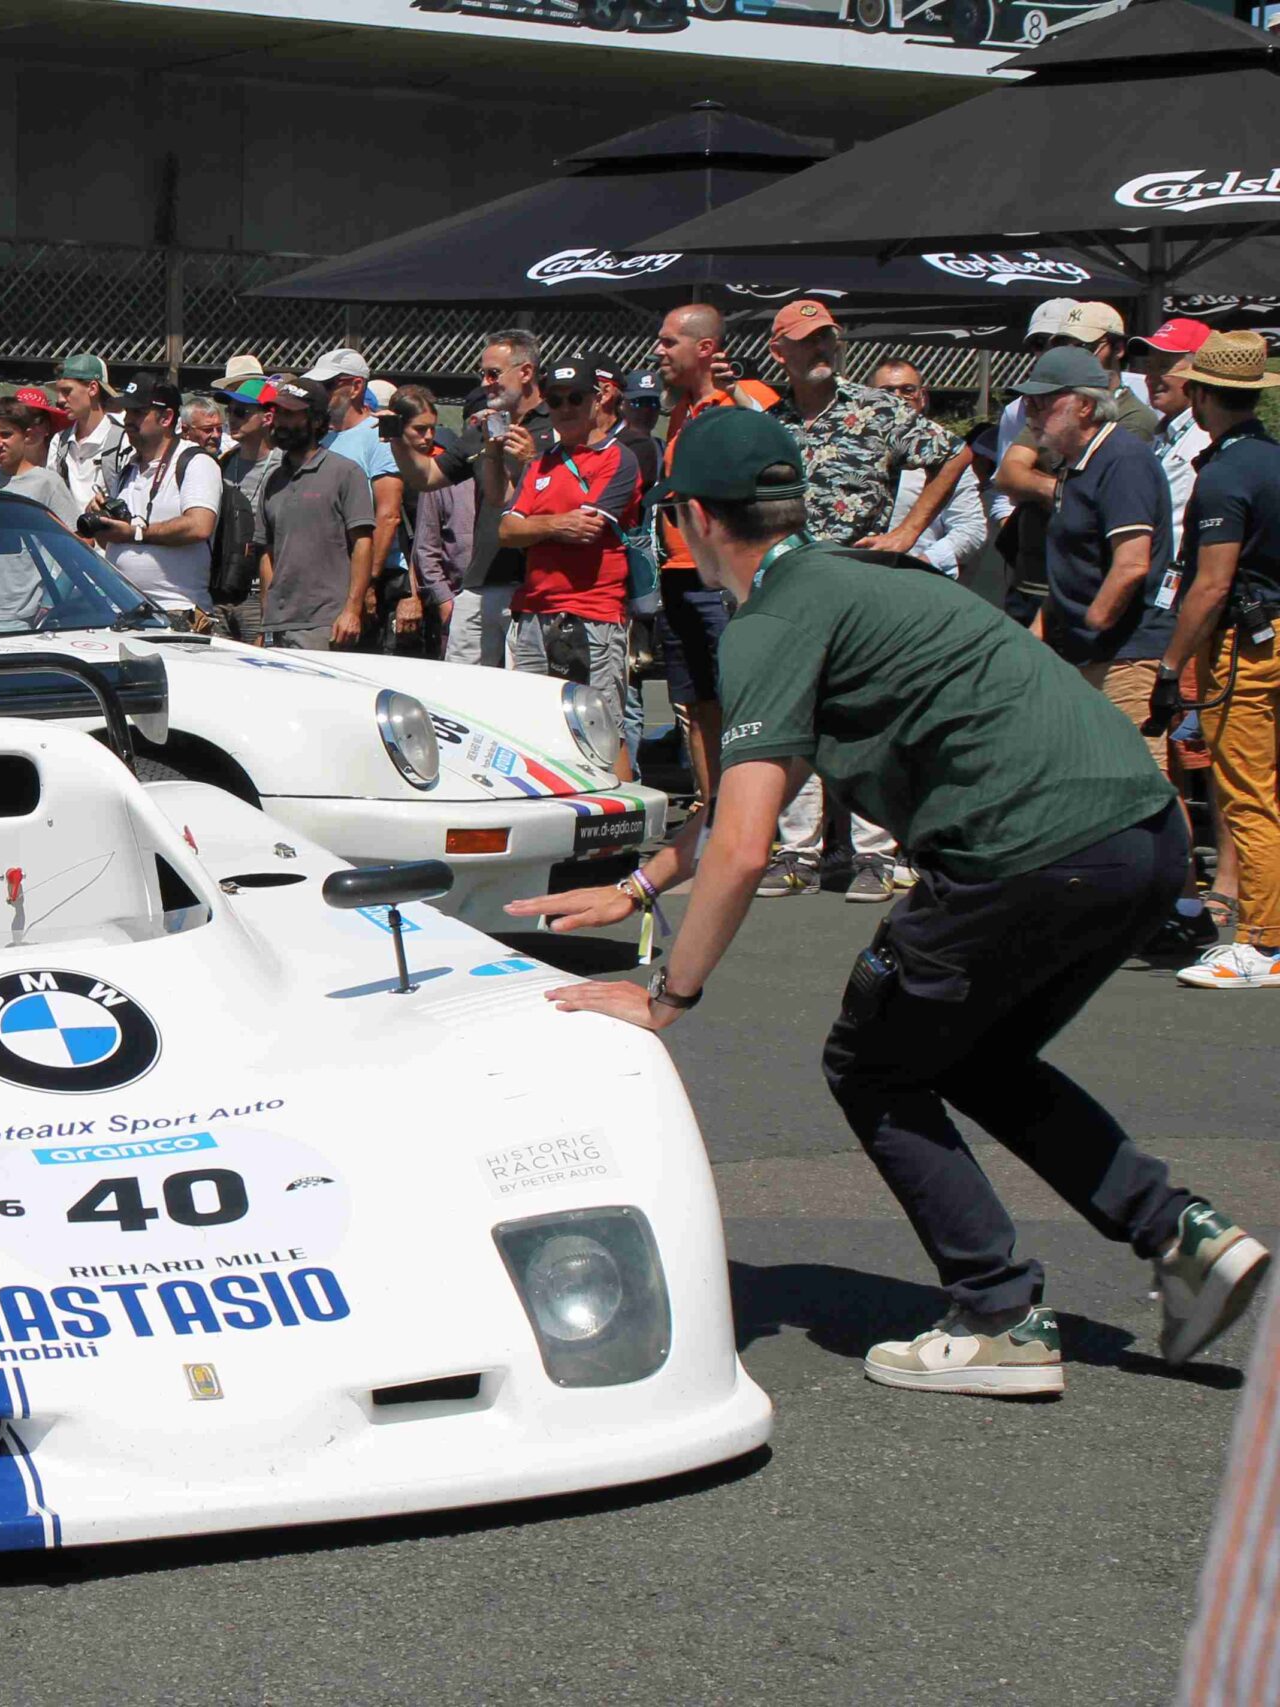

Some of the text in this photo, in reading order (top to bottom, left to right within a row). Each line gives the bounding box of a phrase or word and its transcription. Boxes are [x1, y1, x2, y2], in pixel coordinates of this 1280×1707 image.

[1029, 14, 1042, 40] 8
[108, 1112, 198, 1136] Sport
[206, 1097, 285, 1121] Auto
[50, 1136, 201, 1163] aramco
[486, 1134, 595, 1168] HISTORIC
[491, 1146, 602, 1181] RACING
[499, 1164, 608, 1194] BY PETER AUTO
[65, 1168, 250, 1231] 40
[69, 1247, 308, 1279] RICHARD MILLE
